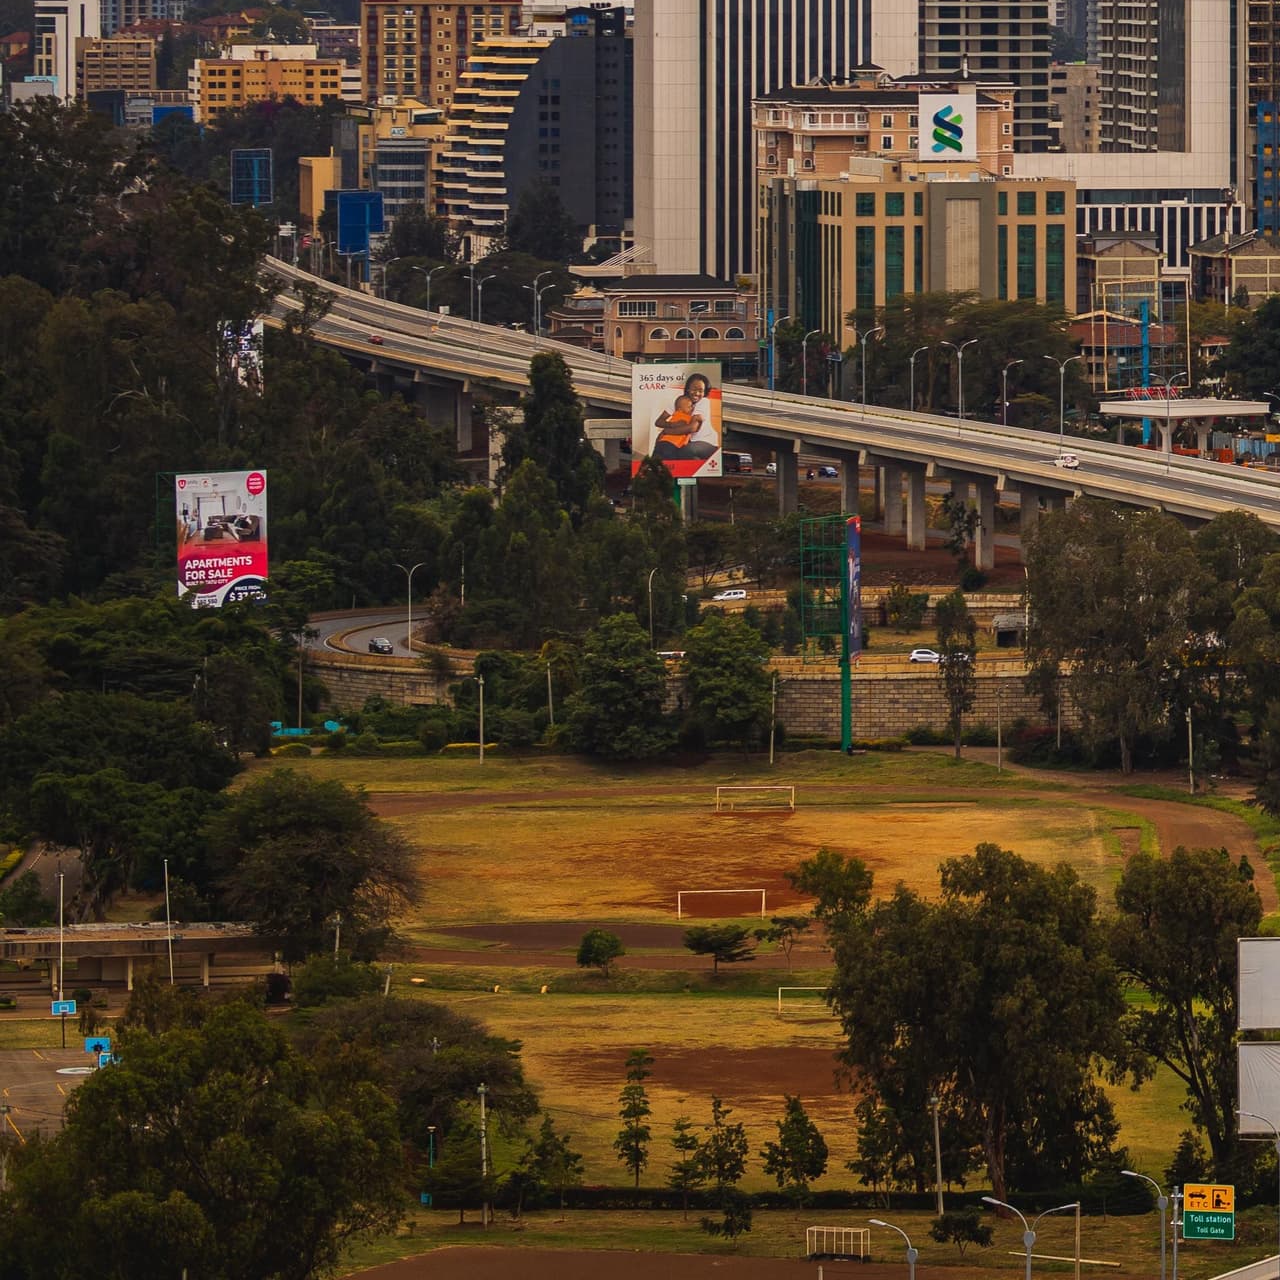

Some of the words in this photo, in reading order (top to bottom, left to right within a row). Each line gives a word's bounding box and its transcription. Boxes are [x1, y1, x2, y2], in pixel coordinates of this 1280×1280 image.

[639, 374, 655, 382] 365
[656, 373, 675, 383] days
[184, 555, 253, 570] APARTMENTS
[185, 570, 206, 581] FOR
[207, 568, 233, 580] SALE
[1190, 1214, 1204, 1223] Toll
[1205, 1215, 1232, 1224] station
[1196, 1226, 1209, 1234] Toll
[1209, 1226, 1225, 1234] Gate
